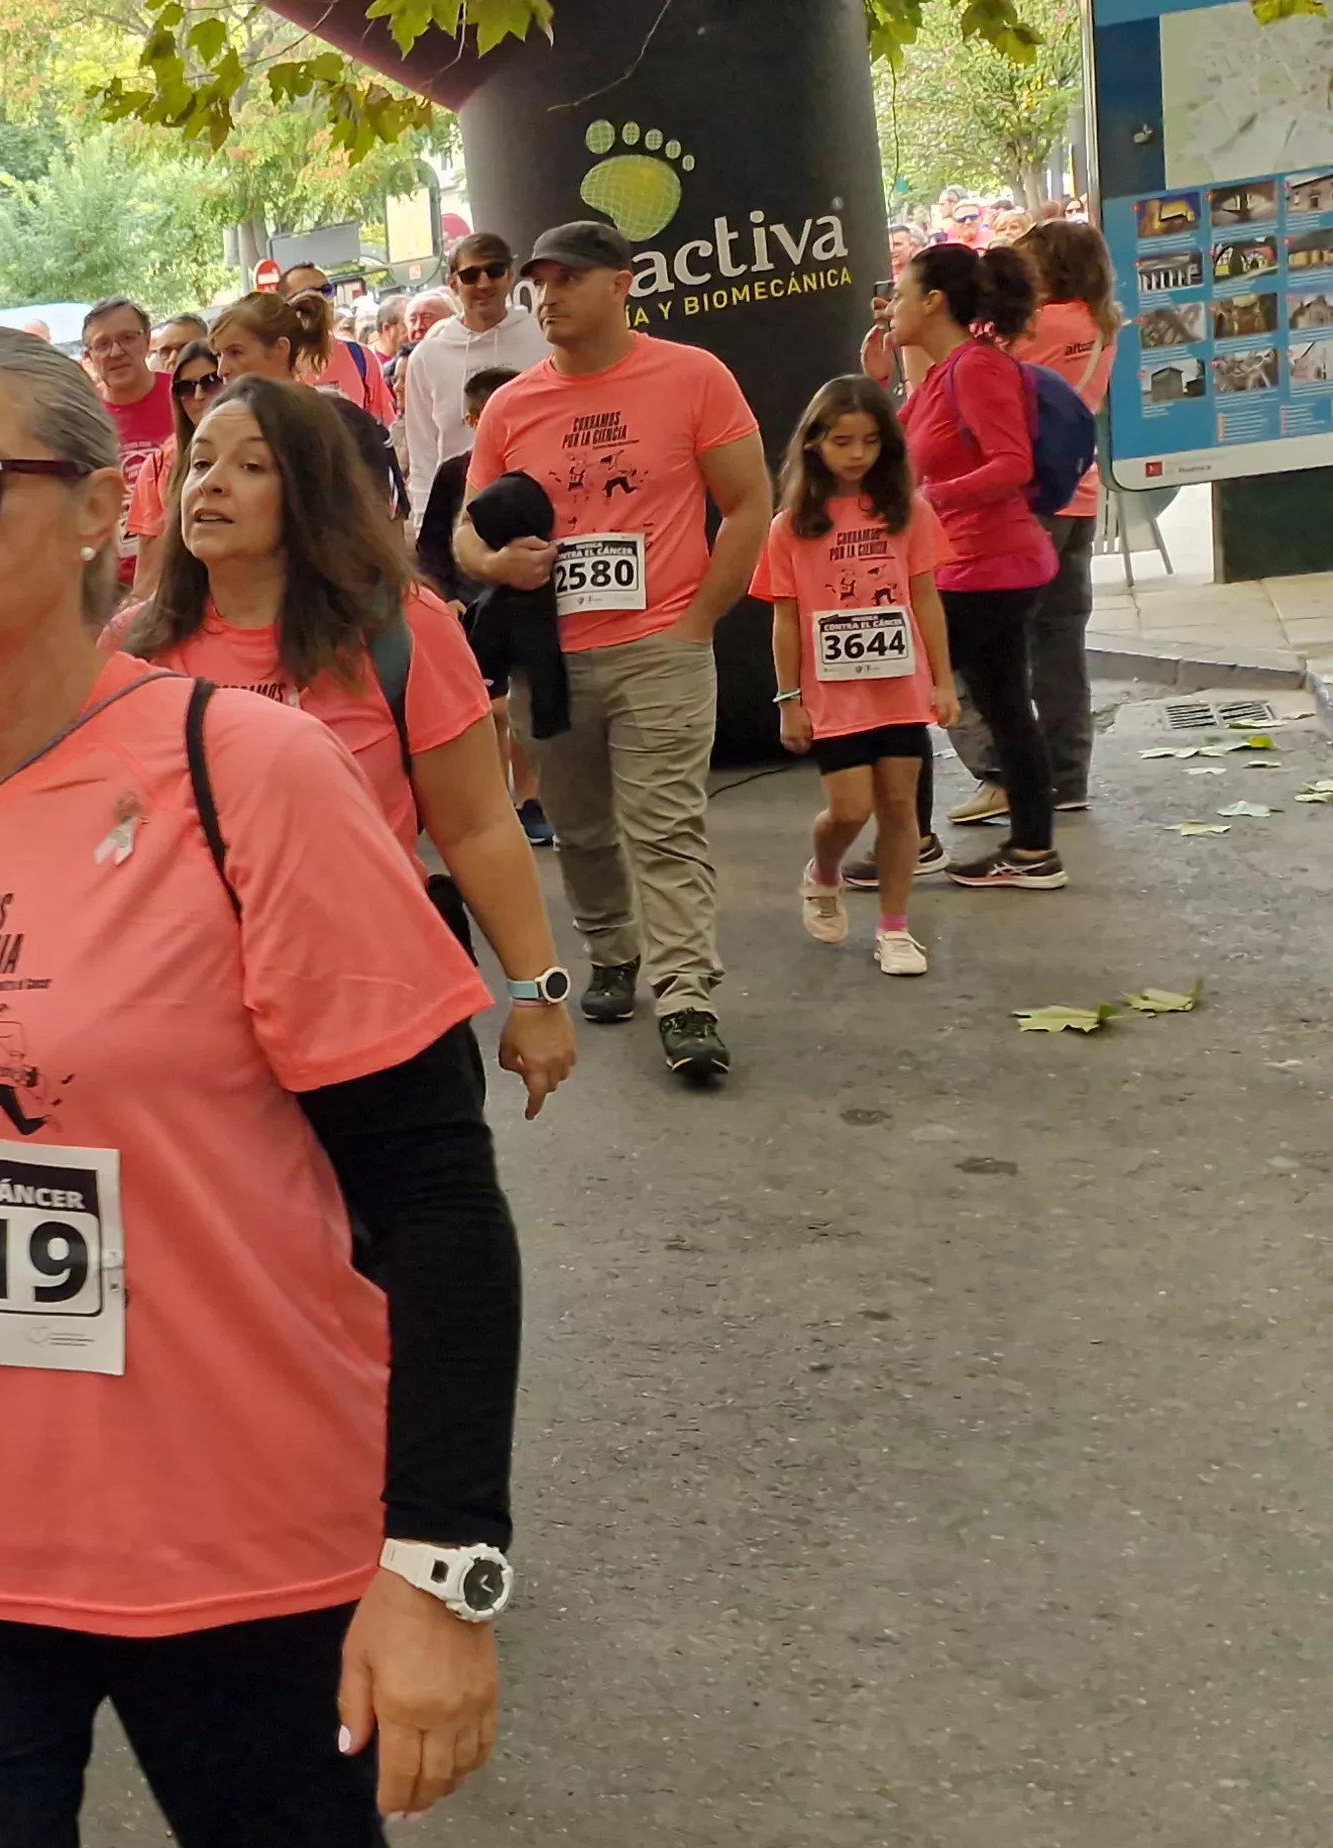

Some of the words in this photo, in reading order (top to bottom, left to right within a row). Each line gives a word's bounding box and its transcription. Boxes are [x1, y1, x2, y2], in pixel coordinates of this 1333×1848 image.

[659, 301, 673, 321] Y
[683, 266, 853, 316] BIOMECÁNICA
[584, 549, 595, 557] EL
[556, 559, 634, 594] 2580
[824, 630, 905, 661] 3644
